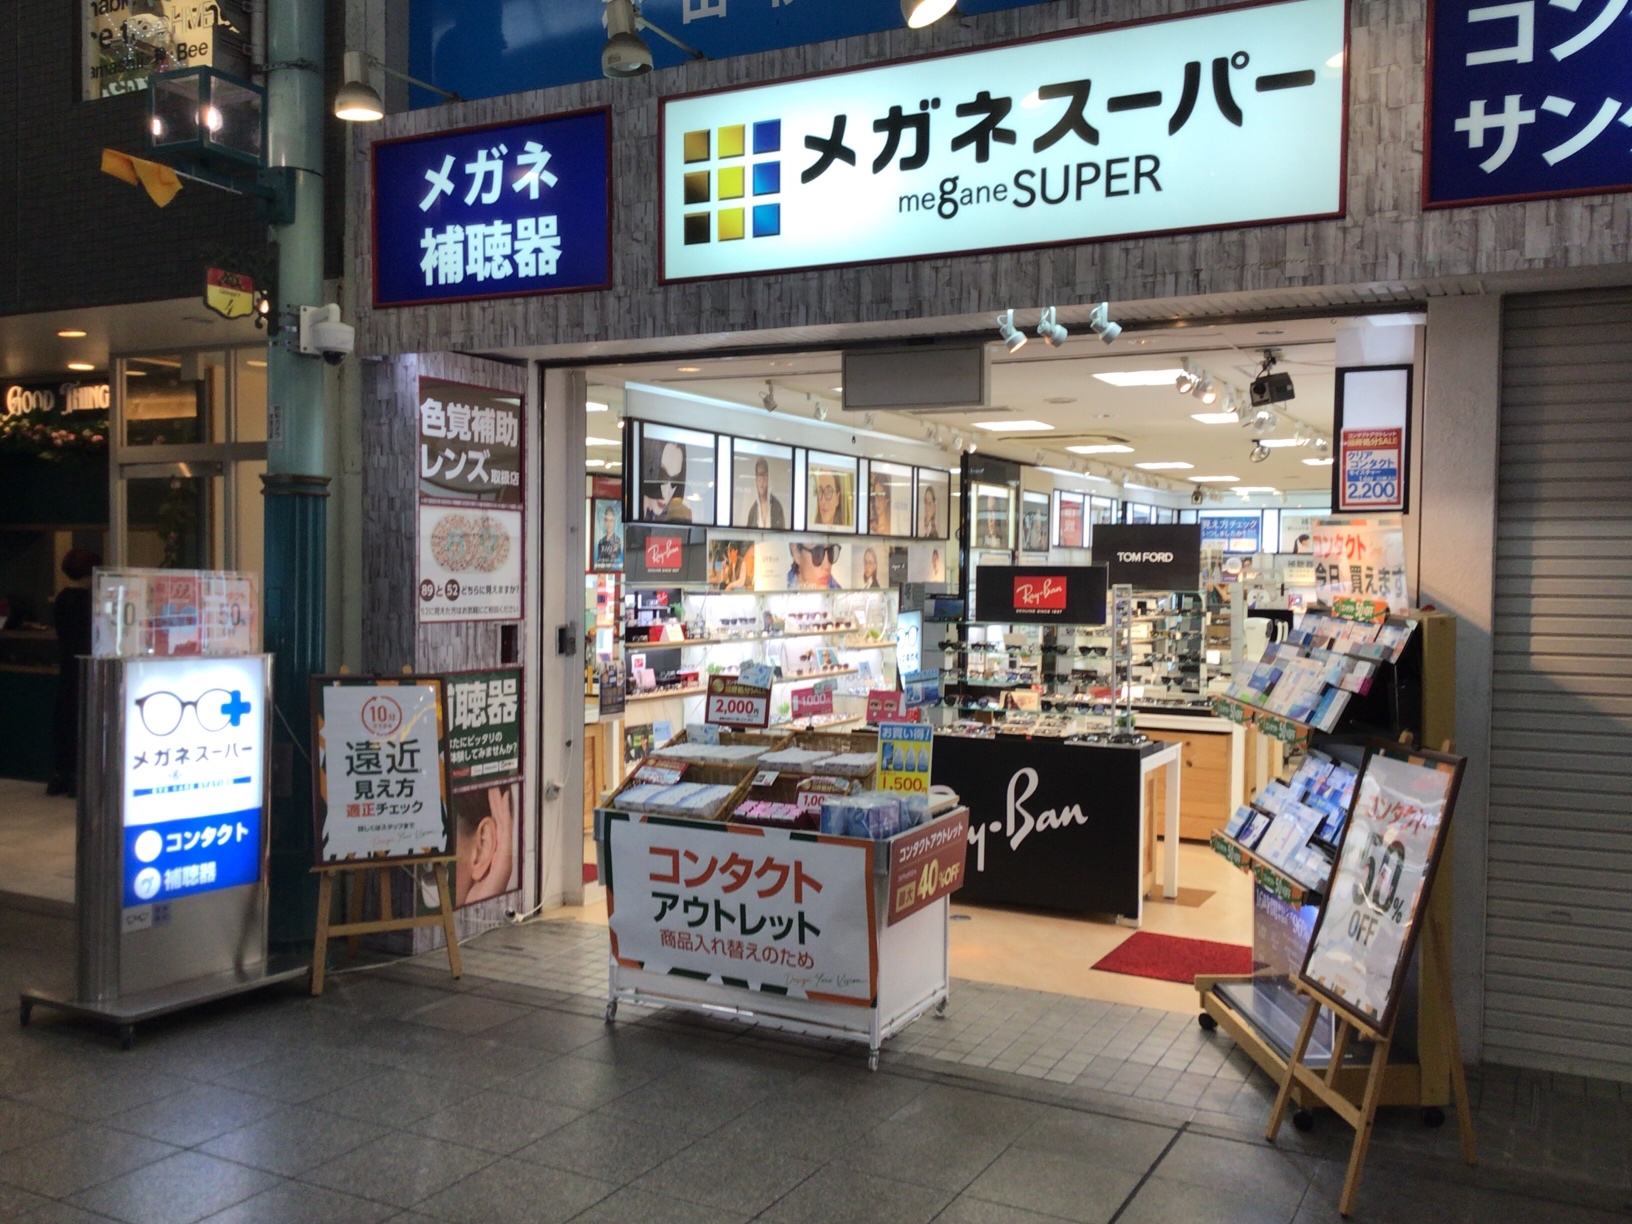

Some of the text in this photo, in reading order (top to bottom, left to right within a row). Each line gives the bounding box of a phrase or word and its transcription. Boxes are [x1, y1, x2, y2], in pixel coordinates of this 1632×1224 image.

[177, 42, 208, 61] Bee
[1466, 0, 1632, 66] コン
[801, 50, 1316, 184] メガネスーパー
[1454, 93, 1632, 175] サン
[418, 140, 559, 213] メガネ
[420, 214, 563, 287] 補聴器
[420, 397, 518, 448] 色覚補助
[421, 444, 490, 484] レンズ
[1348, 450, 1373, 461] クリア
[1350, 457, 1395, 469] コンタクト
[1116, 551, 1174, 563] TOM FORD
[1312, 533, 1367, 561] コンタクト
[370, 705, 396, 722] 10分
[345, 739, 421, 777] 遠近
[354, 777, 416, 800] 見え方
[346, 800, 424, 818] 適正チェック
[166, 822, 249, 853] コンタクト
[899, 822, 964, 864] コンタクトアウトレット
[164, 861, 217, 892] 補聴器
[649, 846, 824, 904] コンタクト
[651, 891, 822, 945] アウトレット
[1348, 910, 1379, 946] OFF
[660, 928, 815, 970] 商品入れ替えのため
